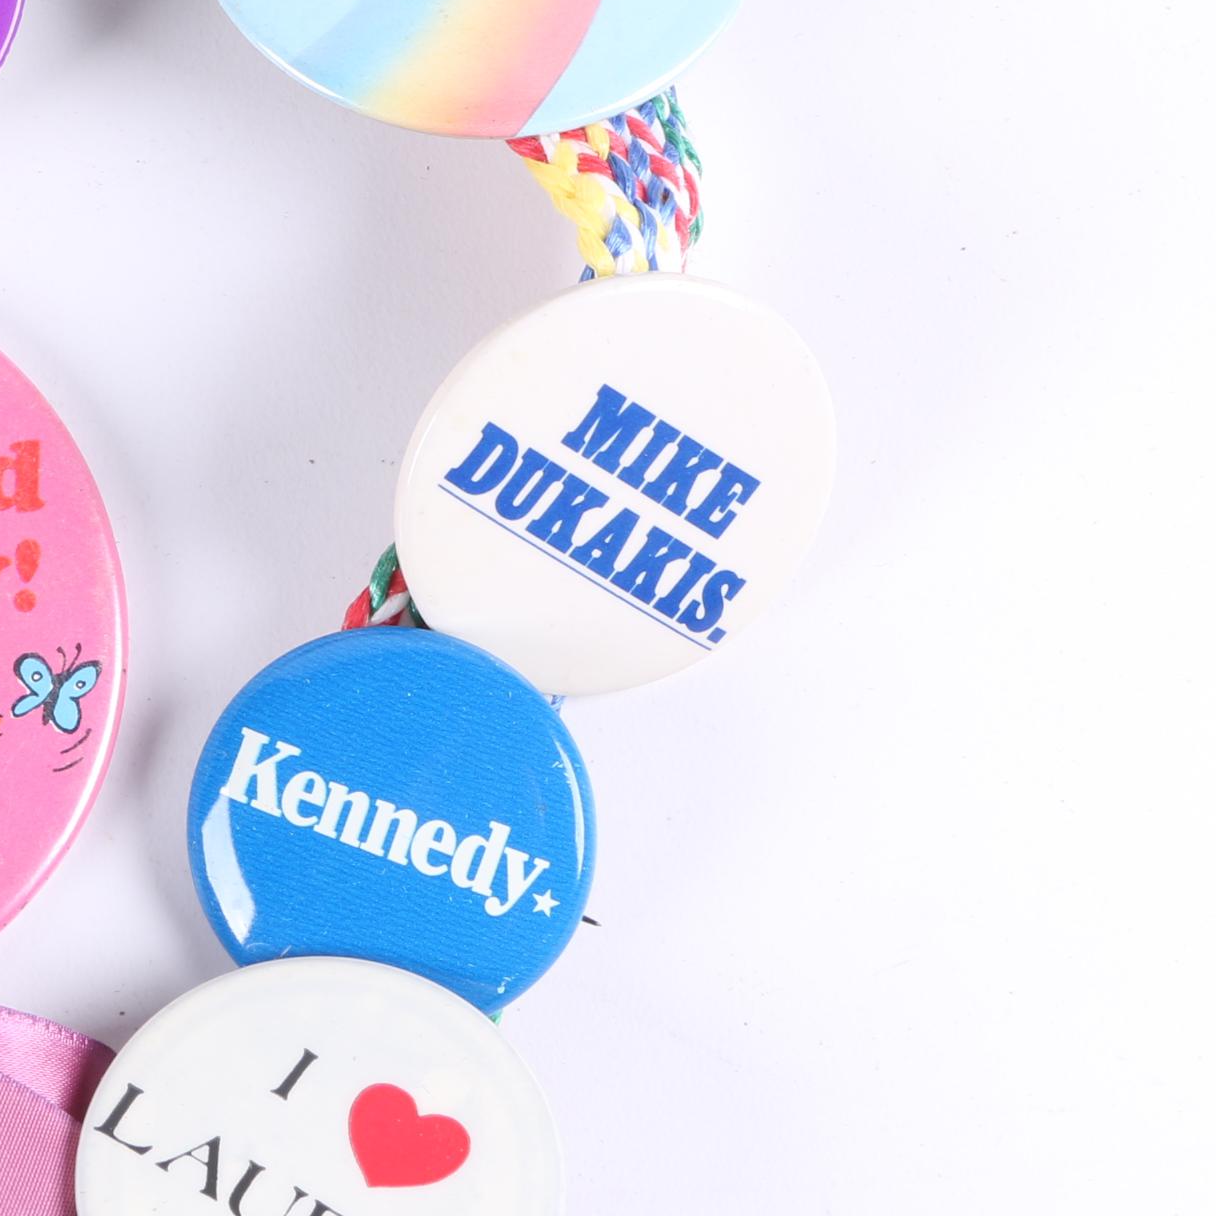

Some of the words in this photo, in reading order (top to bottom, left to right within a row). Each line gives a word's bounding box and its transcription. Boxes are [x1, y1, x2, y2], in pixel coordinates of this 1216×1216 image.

[443, 421, 747, 644] DUKAKIS.
[561, 383, 761, 540] MIKE
[219, 726, 551, 917] Kennedy
[93, 1083, 346, 1216] LAU
[270, 1048, 319, 1101] I
